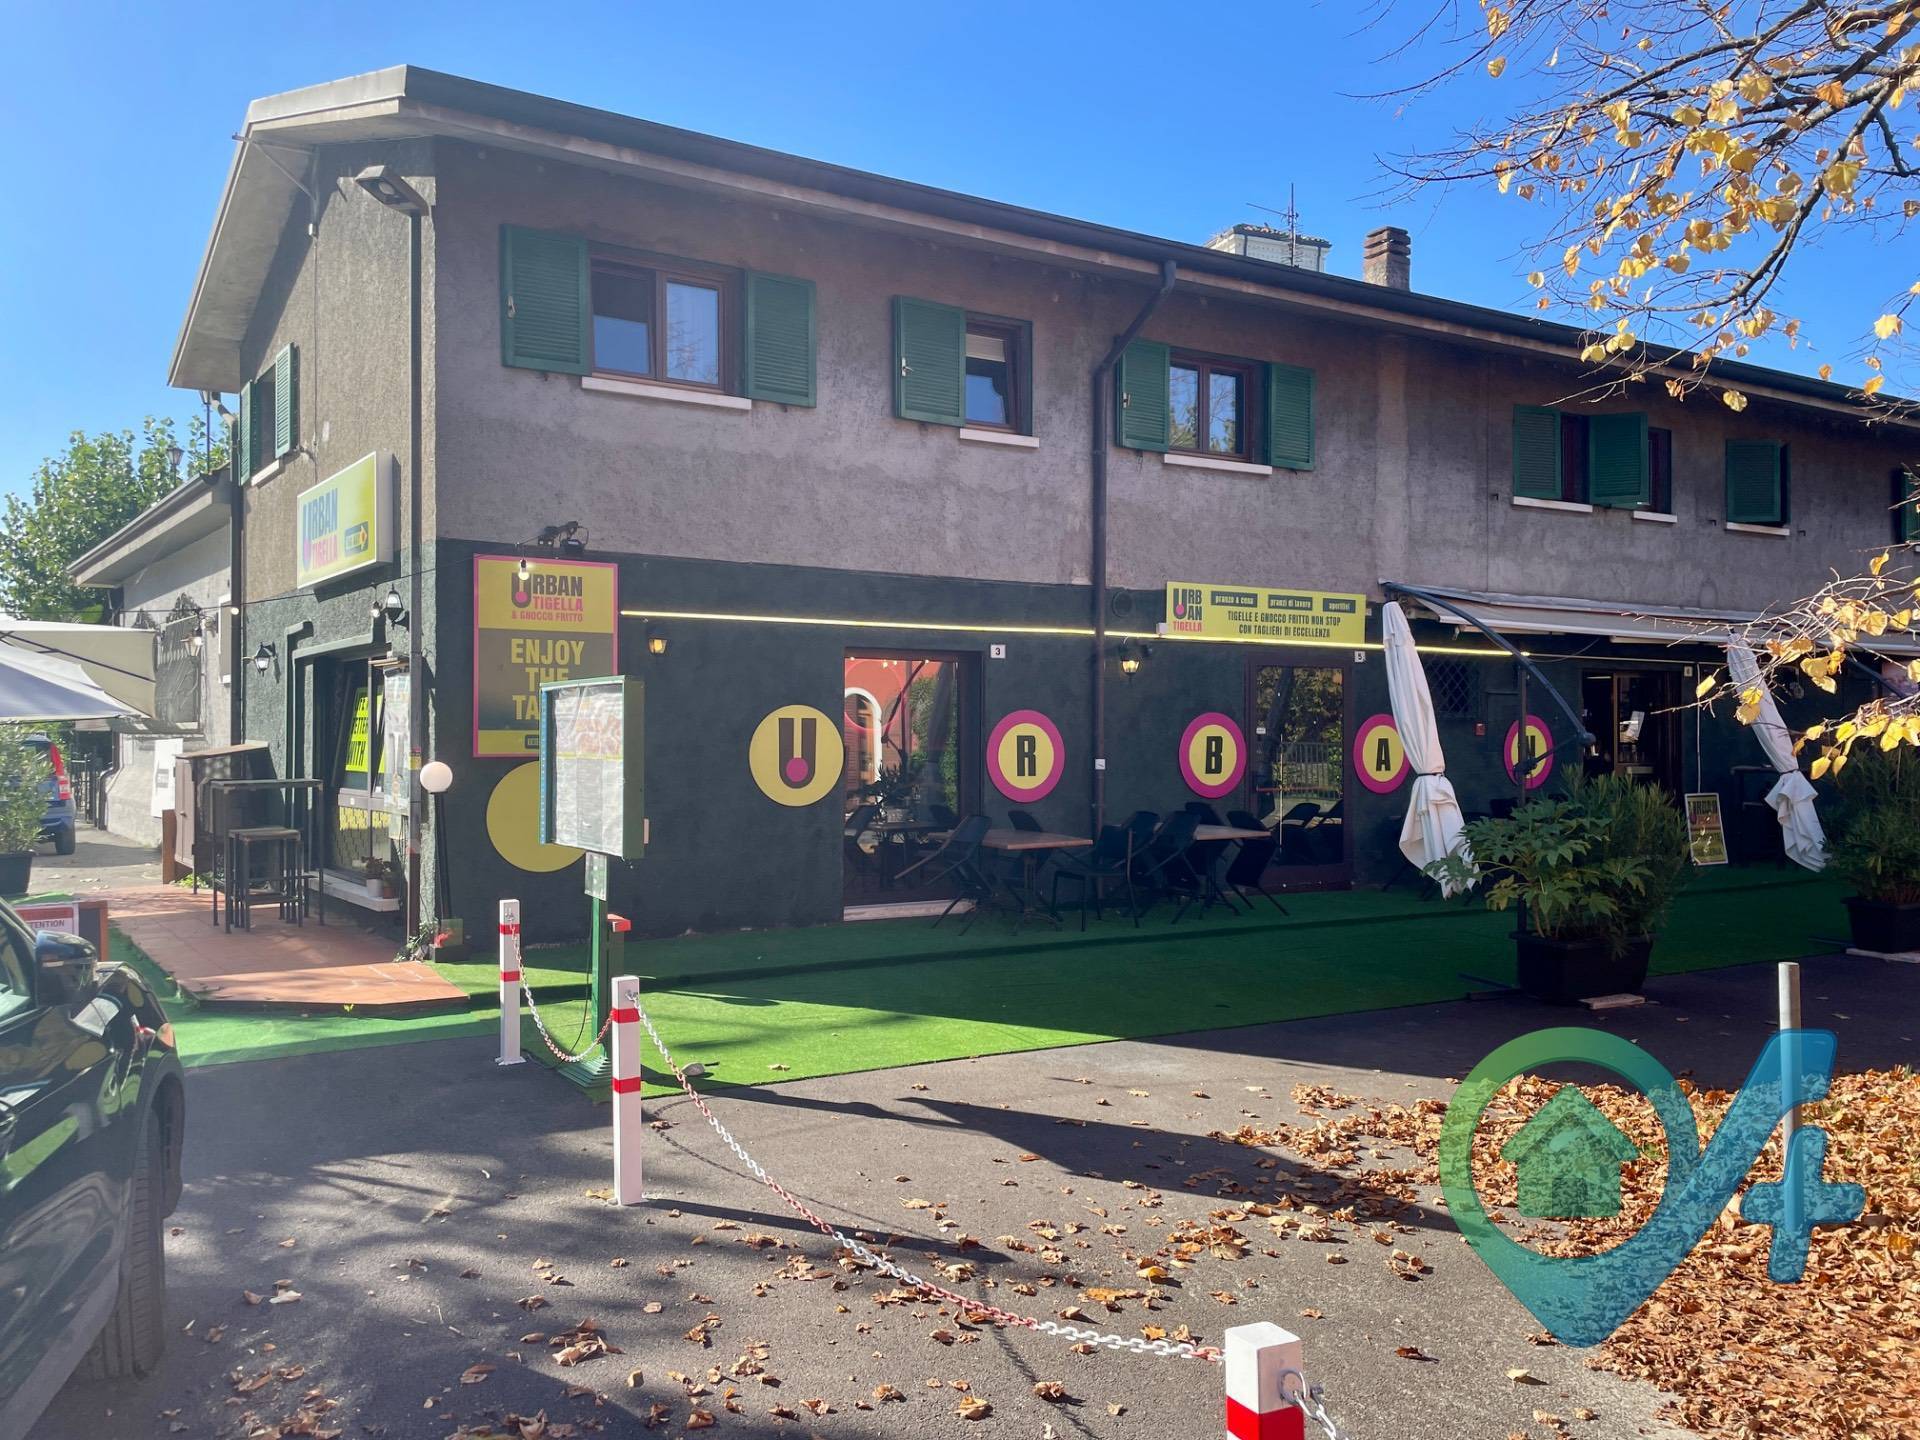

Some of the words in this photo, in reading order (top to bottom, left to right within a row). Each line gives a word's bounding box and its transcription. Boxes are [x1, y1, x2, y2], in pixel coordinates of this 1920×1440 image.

[512, 572, 583, 608] URBAN
[533, 596, 583, 612] TIGELLA
[520, 610, 553, 621] GNOCCO
[556, 612, 583, 622] FRITTO
[1228, 610, 1252, 622] TIGELLE
[1254, 612, 1259, 622] E
[1260, 612, 1286, 624] GNOCCO
[1288, 614, 1310, 625] FRITTO
[1311, 615, 1324, 626] NON
[1326, 616, 1341, 627] STOP
[1173, 621, 1202, 632] TIGELLA
[1239, 624, 1252, 634] CON
[1254, 625, 1282, 636] TAGLIERI
[1284, 626, 1292, 636] DI
[1293, 627, 1331, 638] ECCELLENZA
[511, 638, 585, 666] ENJOY
[995, 647, 1001, 656] 3
[778, 718, 817, 789] U
[1016, 735, 1037, 777] R
[1205, 735, 1223, 775] B
[1375, 737, 1392, 772] A
